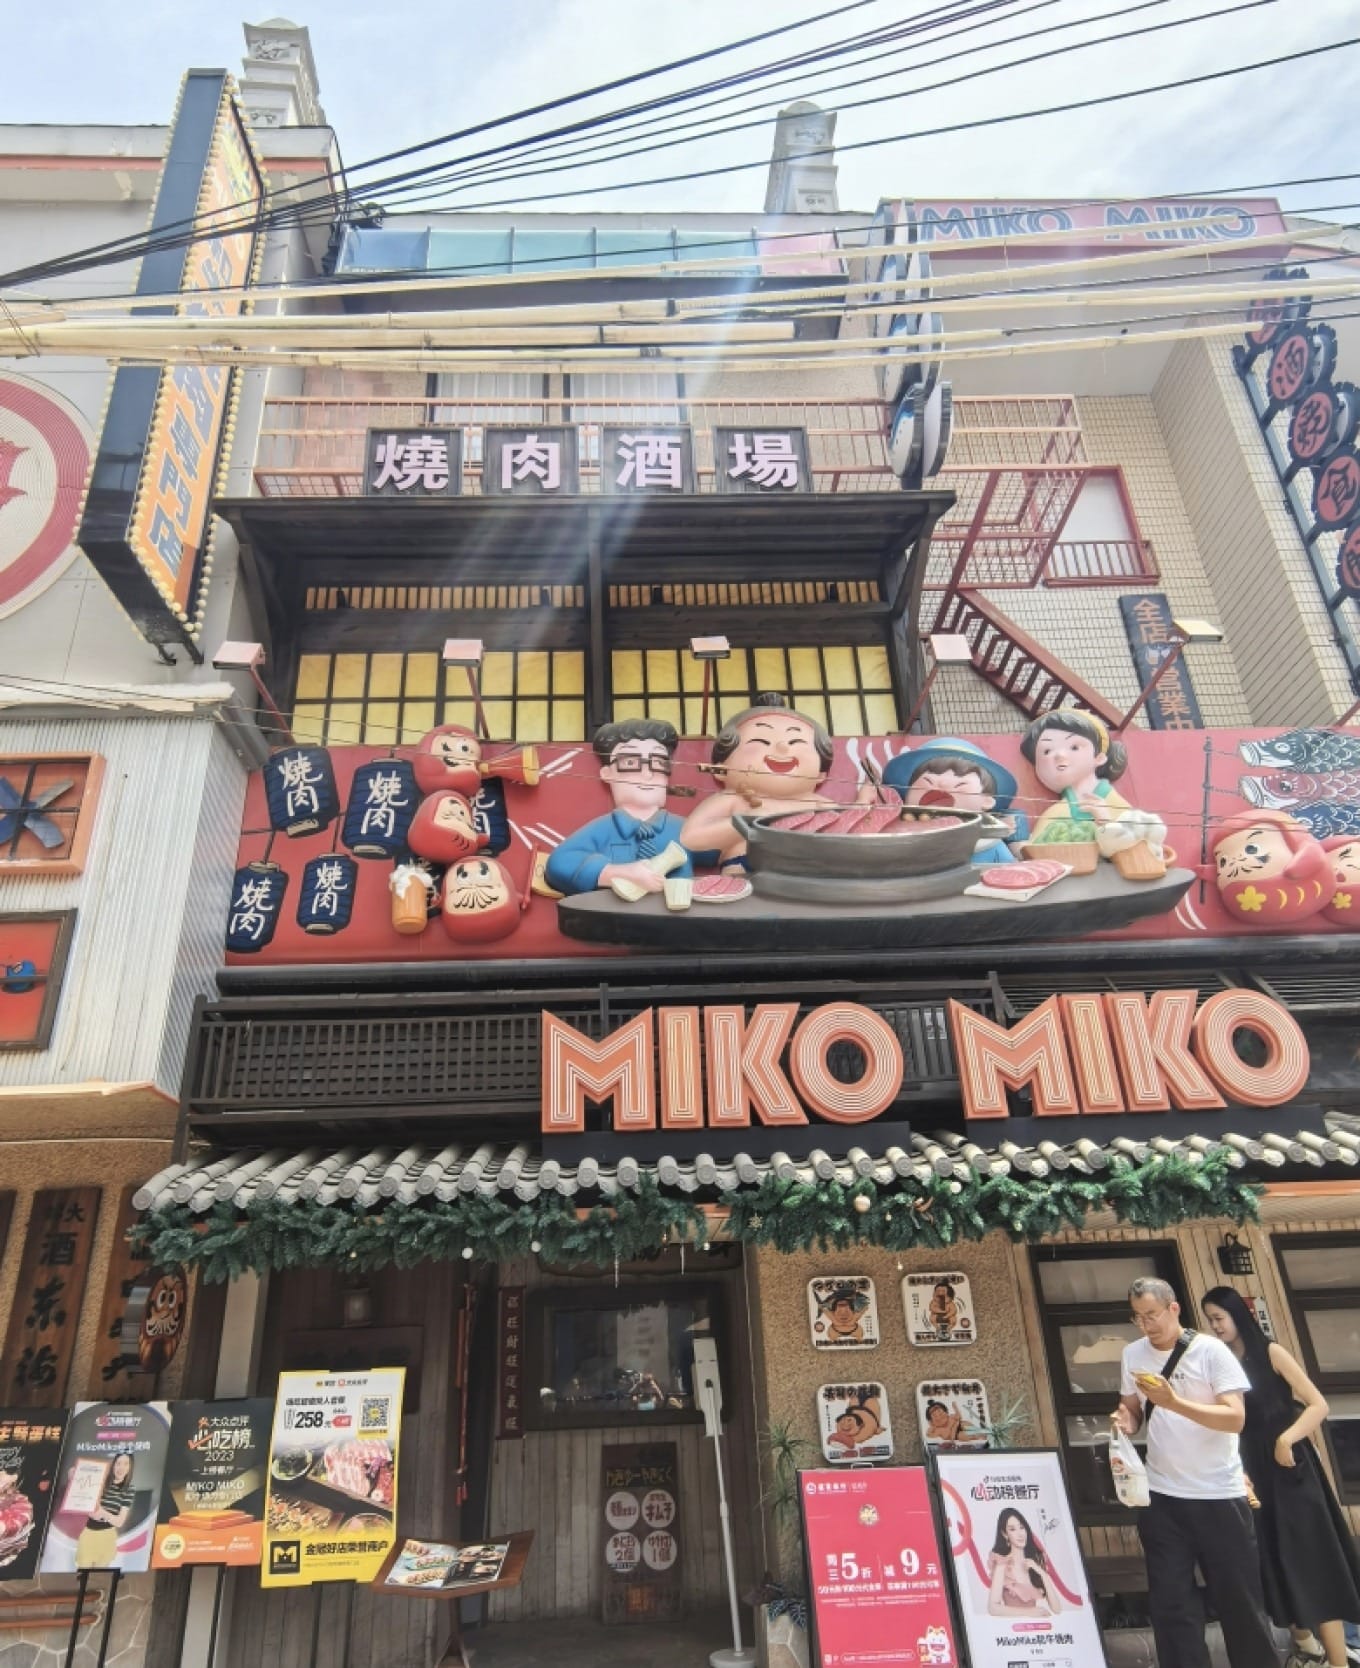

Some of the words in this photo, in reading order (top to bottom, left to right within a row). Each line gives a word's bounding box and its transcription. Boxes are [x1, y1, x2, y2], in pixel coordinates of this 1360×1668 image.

[922, 204, 1074, 241] MIKO
[1104, 203, 1257, 242] MIKO
[541, 1001, 904, 1133] MIKO
[950, 987, 1311, 1120] MIKO
[294, 1411, 324, 1429] 258
[204, 1450, 235, 1462] 2023
